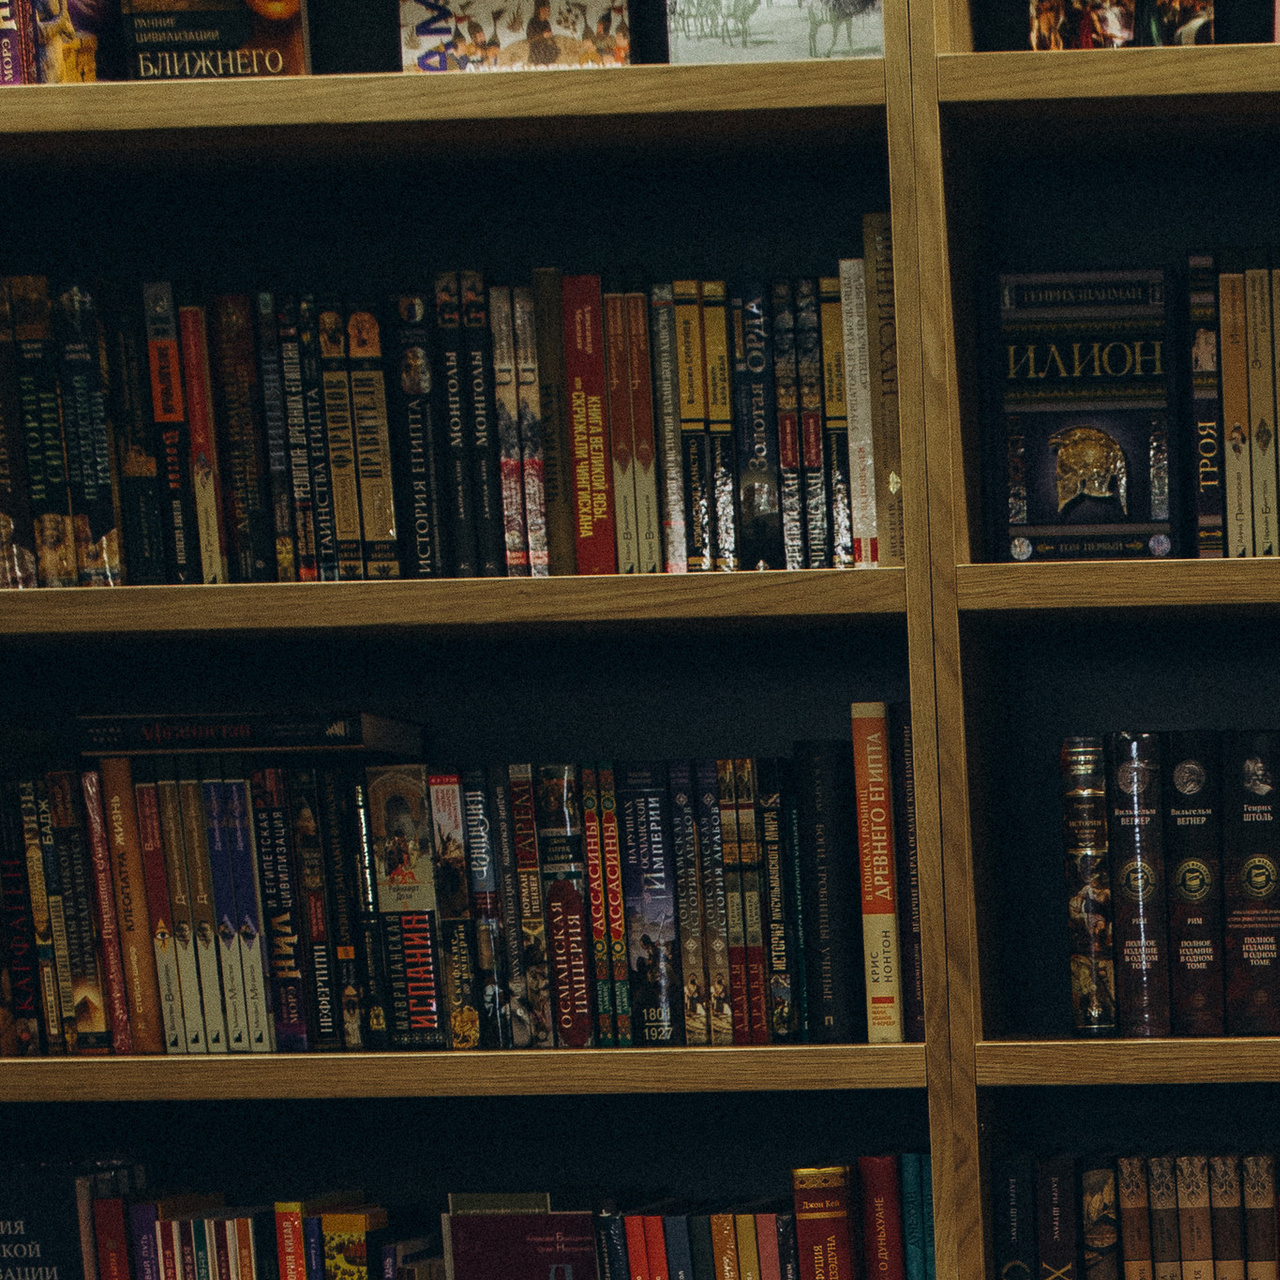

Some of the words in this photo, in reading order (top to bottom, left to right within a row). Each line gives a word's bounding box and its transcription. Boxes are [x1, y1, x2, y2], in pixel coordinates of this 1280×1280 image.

[139, 49, 283, 77] БЛИЖНЕГО
[445, 352, 464, 448] МОНГОЛЫ
[470, 351, 488, 446] МОНГОЛЫ
[1006, 339, 1164, 380] ИЛИОН
[405, 399, 427, 474] ЕГИПТА
[570, 391, 587, 451] СКРИЖАЛИ
[1197, 420, 1219, 492] ТРОЯ
[413, 481, 433, 573] ИСТОРИЯ
[576, 455, 594, 538] ЧИНГИСХАНА
[866, 731, 885, 800] ЕГИПТА
[110, 795, 126, 846] ЖИЗНЬ
[258, 812, 274, 894] ЕГИПЕТСКАЯ
[272, 811, 292, 908] ЦИВИЛИЗАЦИЯ
[511, 781, 536, 867] ГАРЕМ
[643, 796, 667, 891] ИМПЕРИИ
[870, 807, 892, 901] ДРЕВНЕГО
[116, 852, 135, 932] КЛЕОПАТРА
[266, 899, 277, 908] И
[585, 821, 603, 931] АССАСИНЫ
[603, 821, 623, 932] АССАСИНЫ
[271, 912, 300, 979] НИЛ
[400, 914, 438, 1029] ИСПАНИЯ
[549, 902, 573, 1029] ОСМАНСКАЯ
[567, 914, 587, 1015] ИМПЕРИЯ
[869, 951, 881, 983] КРИС
[881, 930, 893, 983] НОНТОН
[313, 944, 333, 1033] НЕФЕРТИТИ
